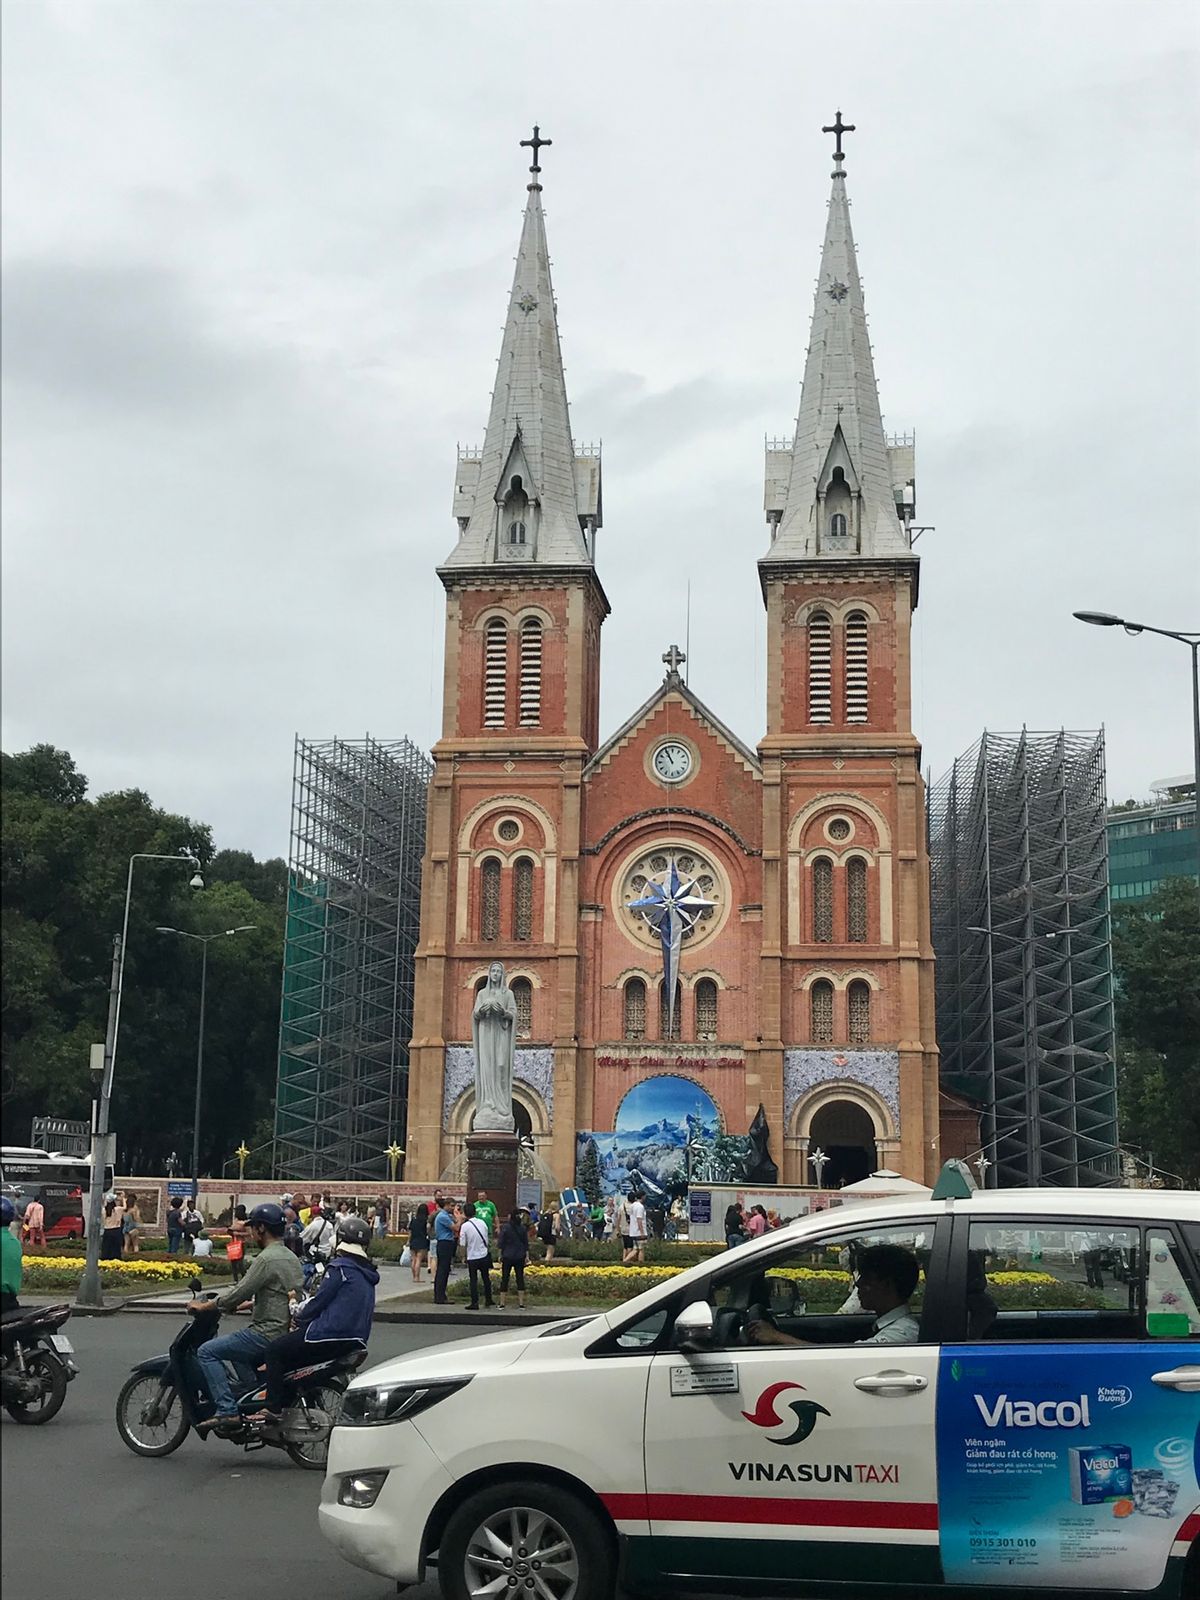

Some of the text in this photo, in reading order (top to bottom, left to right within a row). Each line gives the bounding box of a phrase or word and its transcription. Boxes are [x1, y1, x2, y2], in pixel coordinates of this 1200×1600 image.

[974, 1394, 1091, 1427] Viacol
[989, 1449, 1006, 1458] đau
[1083, 1456, 1119, 1471] Viacol
[969, 1537, 1037, 1547] 0915 301 010
